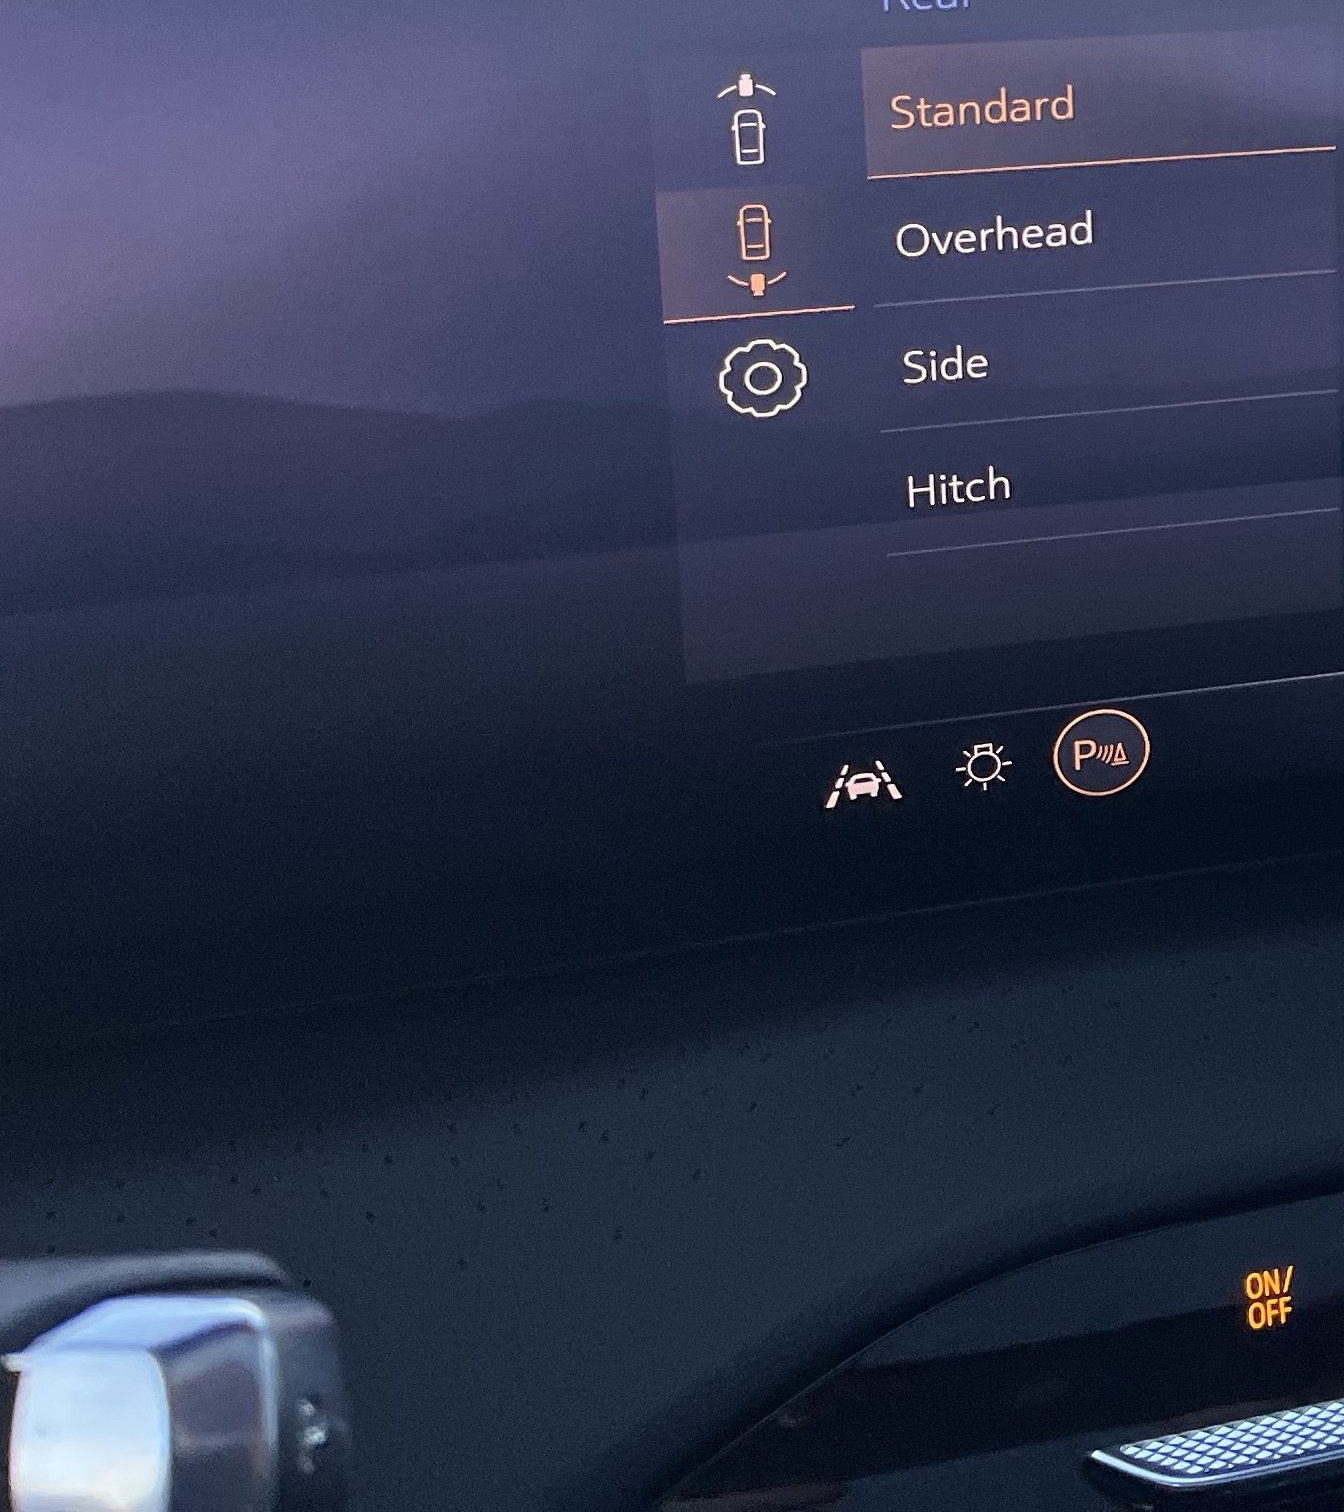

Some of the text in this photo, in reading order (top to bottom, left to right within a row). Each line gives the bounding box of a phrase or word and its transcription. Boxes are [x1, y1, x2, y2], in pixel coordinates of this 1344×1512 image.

[890, 84, 1075, 130] Standard
[895, 209, 1093, 258] Overhead
[902, 344, 989, 385] Side
[907, 465, 1012, 508] Hitch
[1245, 1265, 1294, 1300] ON/
[1248, 1296, 1292, 1330] OFF
